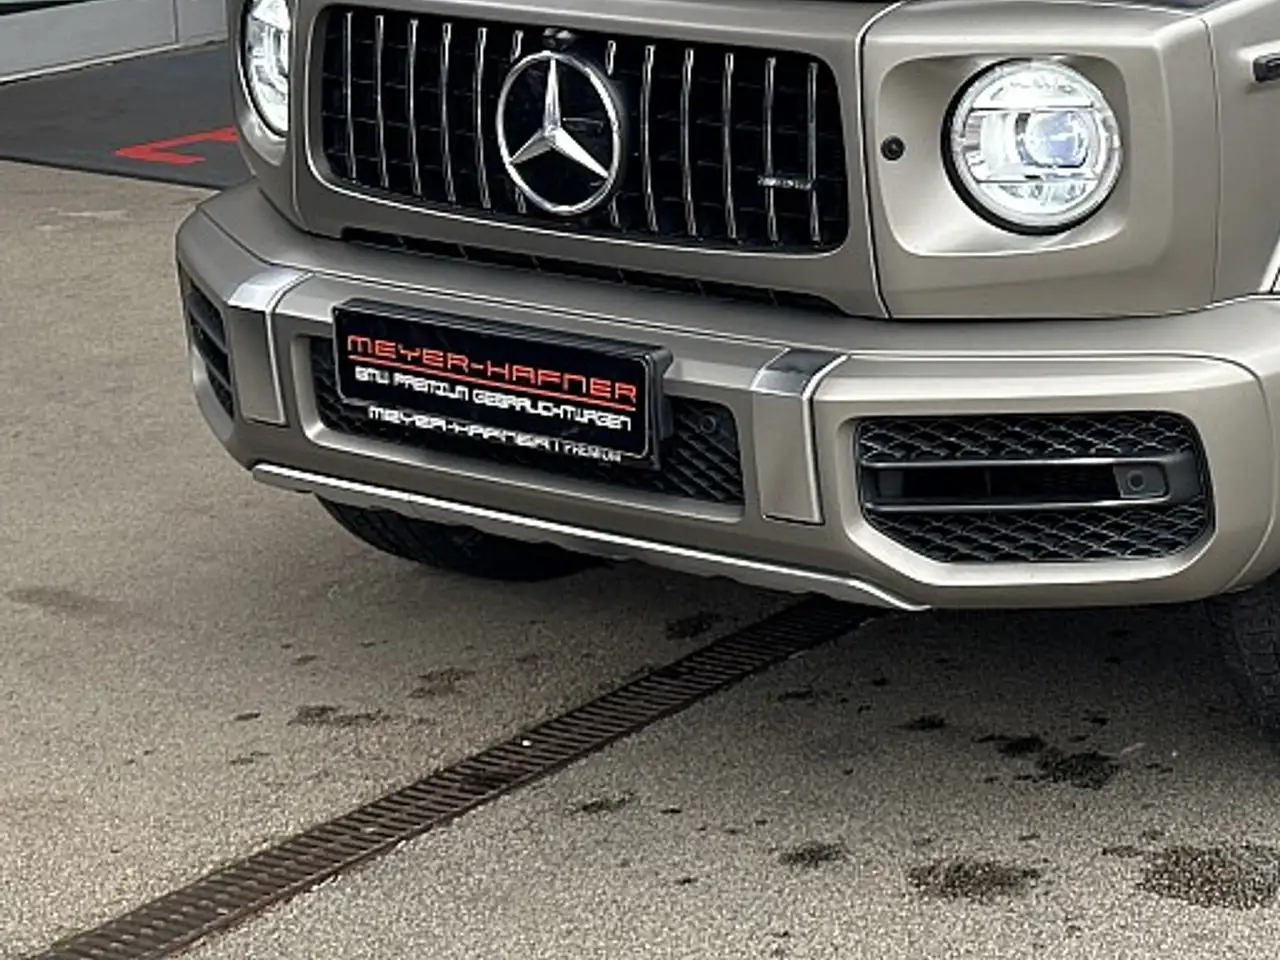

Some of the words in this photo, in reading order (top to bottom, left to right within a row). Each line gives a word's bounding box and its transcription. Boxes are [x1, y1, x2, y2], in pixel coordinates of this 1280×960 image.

[348, 335, 637, 404] MEYER-HAFNER
[393, 372, 469, 401] PREMIUM
[472, 389, 632, 432] GEBRAUCHTWAGEN
